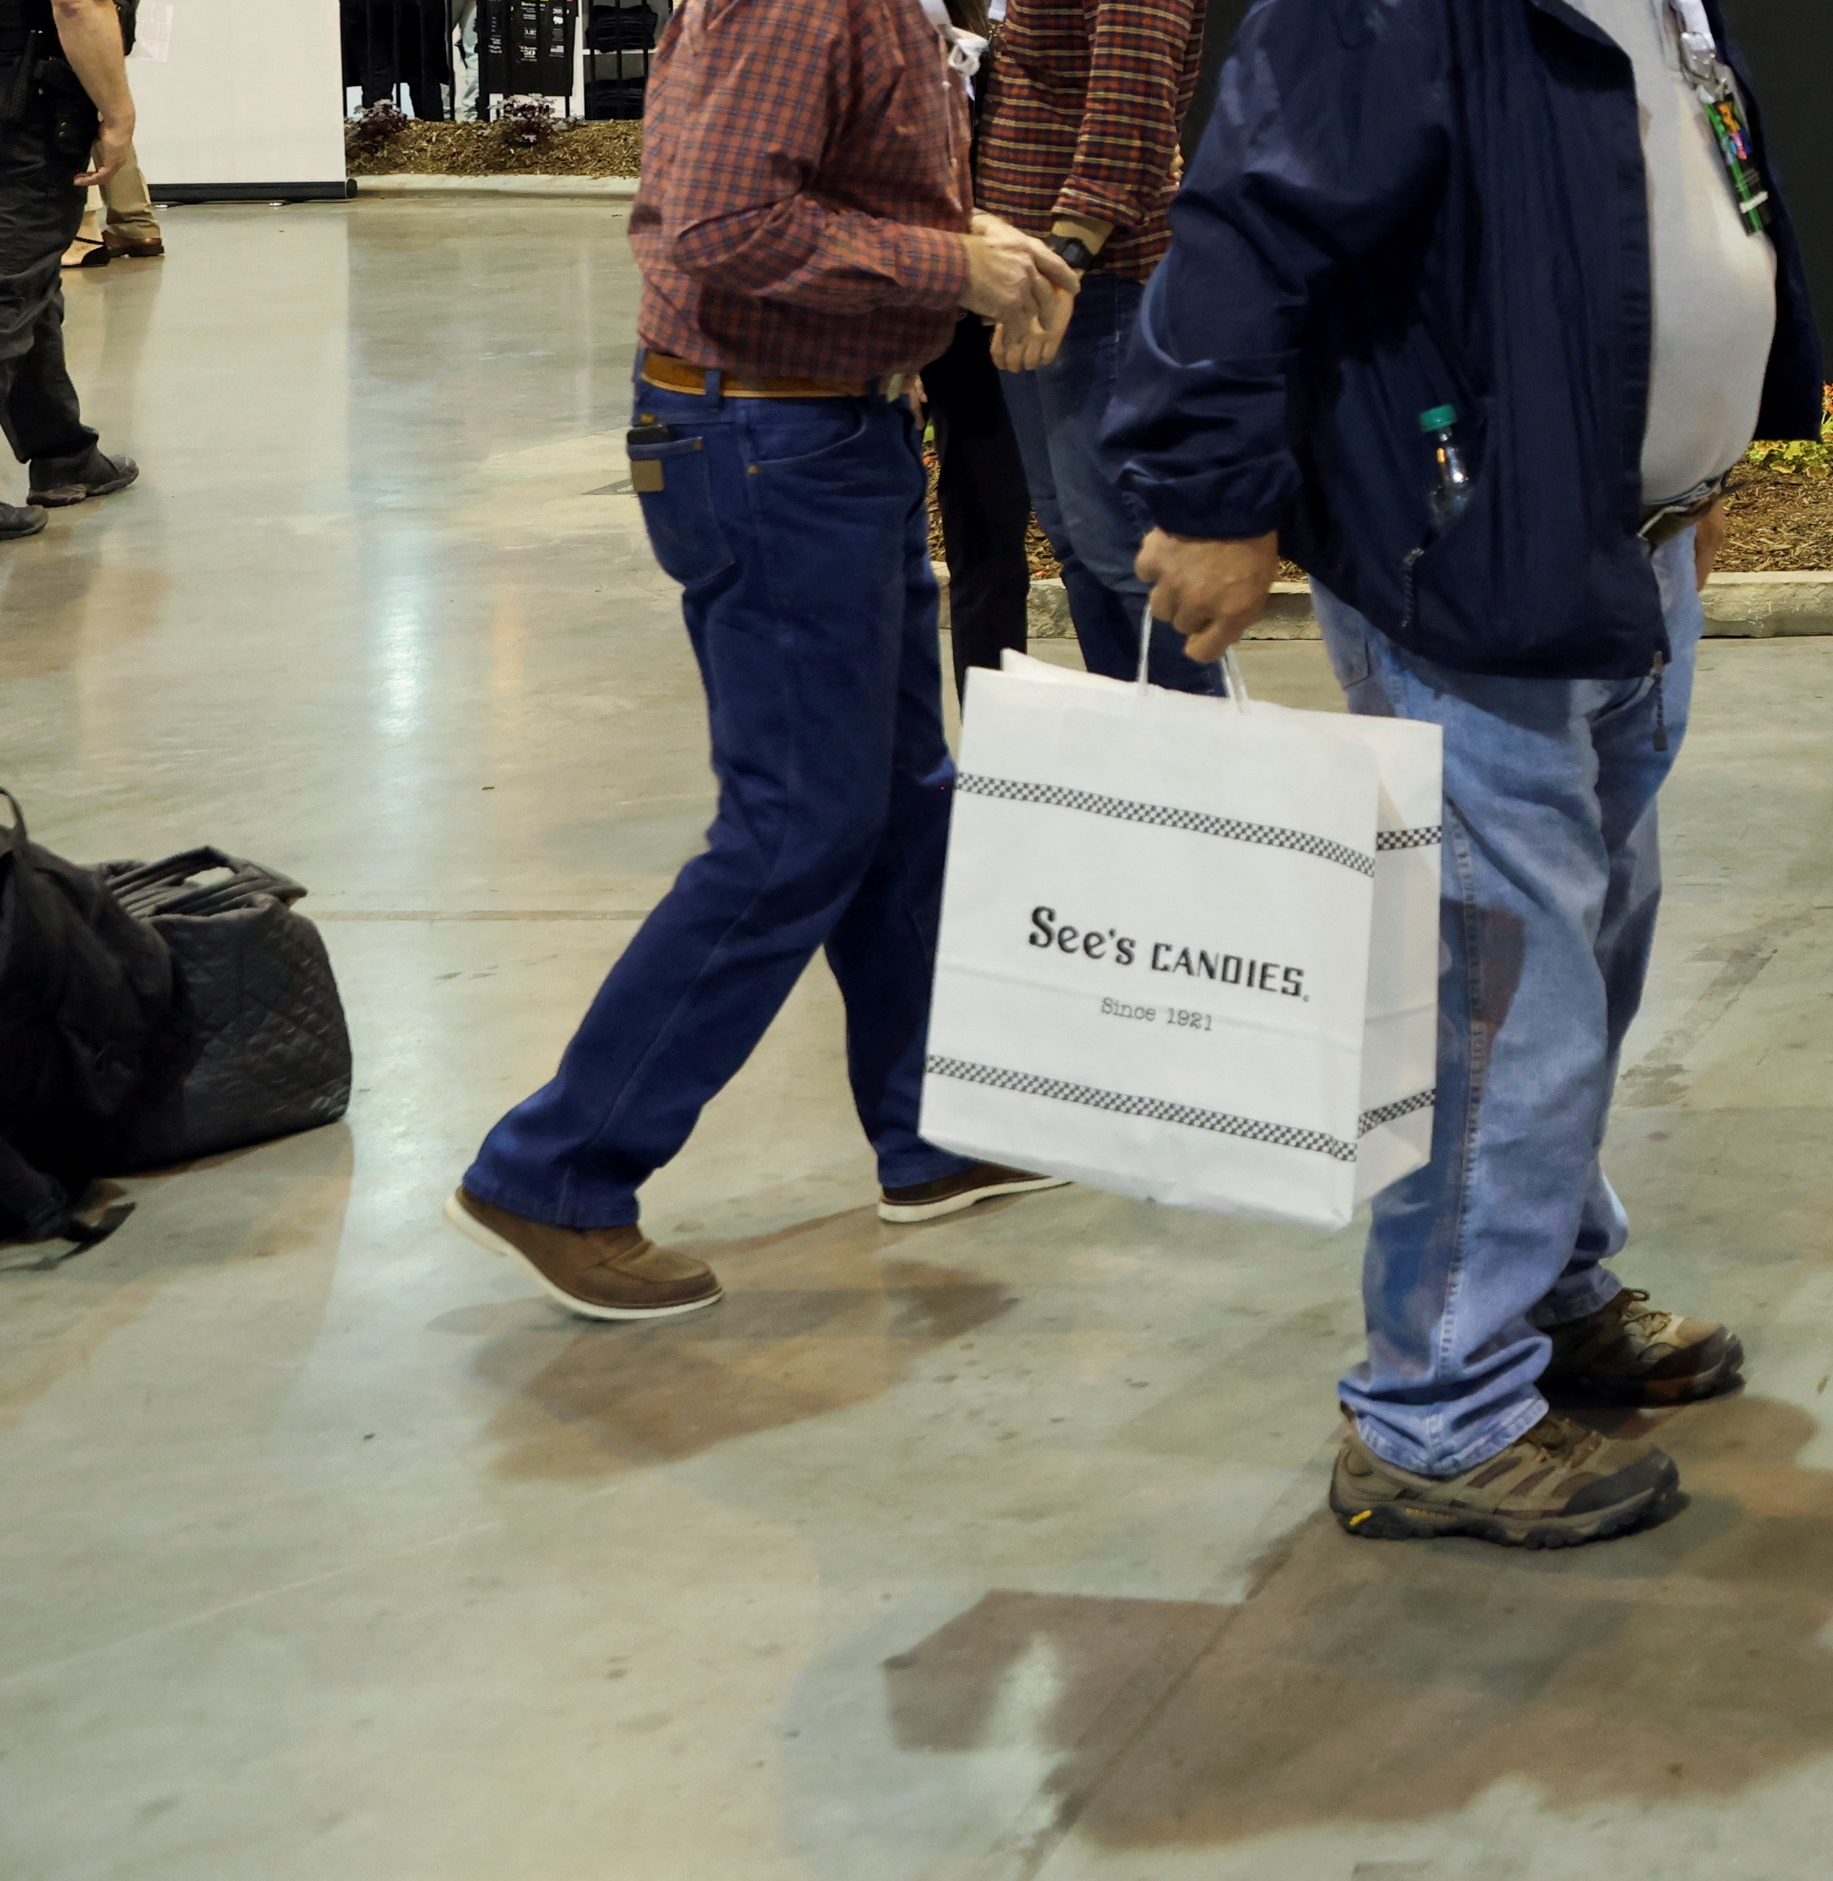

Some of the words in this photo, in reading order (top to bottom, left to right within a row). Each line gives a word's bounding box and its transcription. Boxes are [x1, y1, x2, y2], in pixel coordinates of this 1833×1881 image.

[1028, 905, 1137, 966] See's
[1100, 996, 1158, 1023] Since
[1166, 1007, 1215, 1032] 1921
